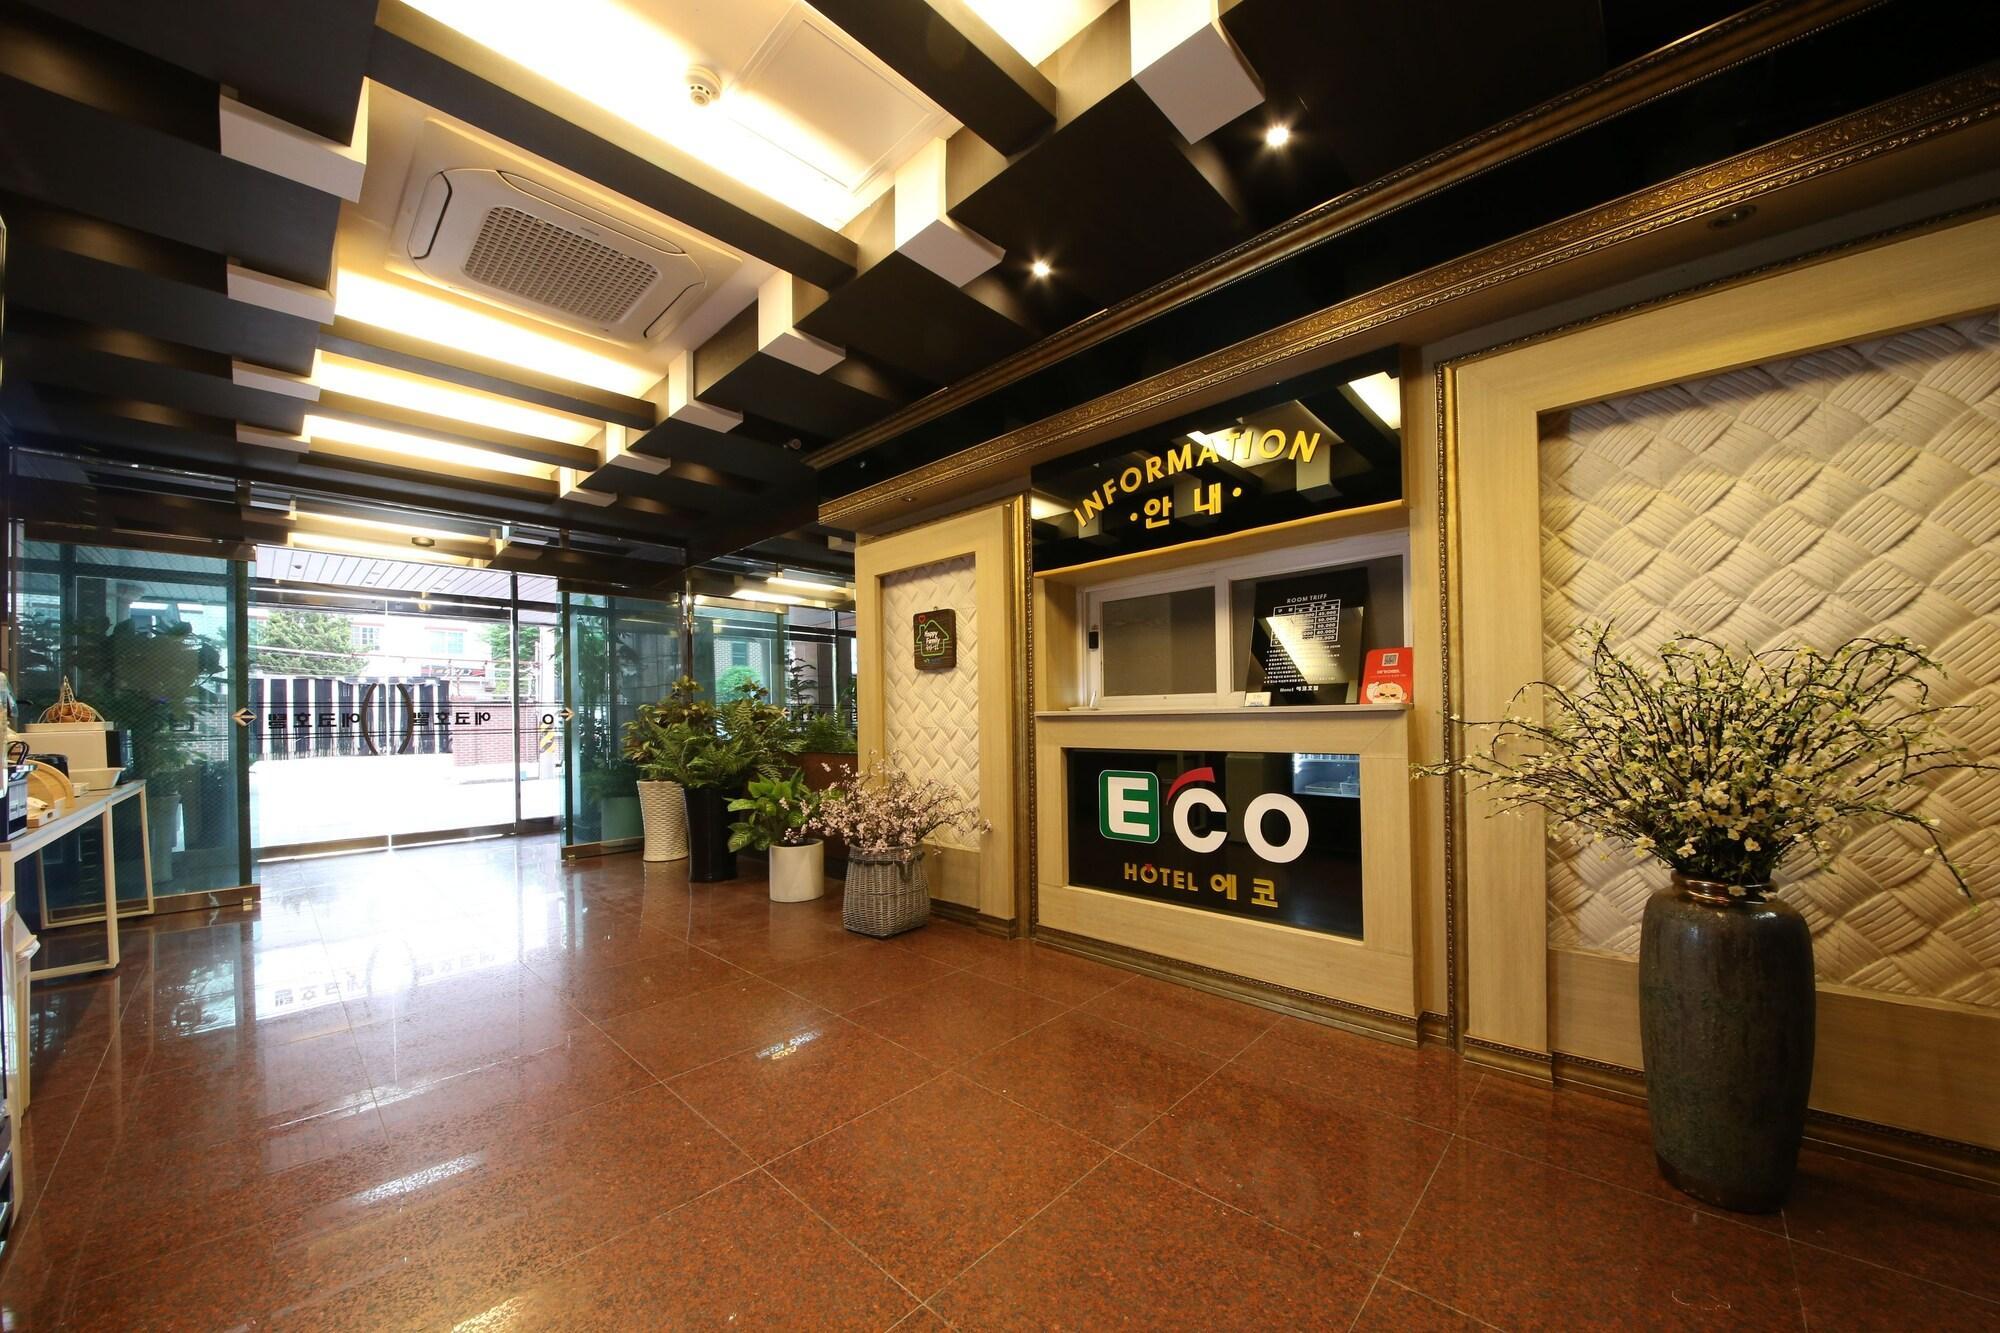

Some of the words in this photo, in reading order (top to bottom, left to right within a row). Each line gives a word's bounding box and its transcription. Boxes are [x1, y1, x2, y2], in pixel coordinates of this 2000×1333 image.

[1073, 428, 1322, 527] INFORMATION
[1107, 776, 1310, 864] ECO
[1124, 862, 1199, 892] HOTEL
